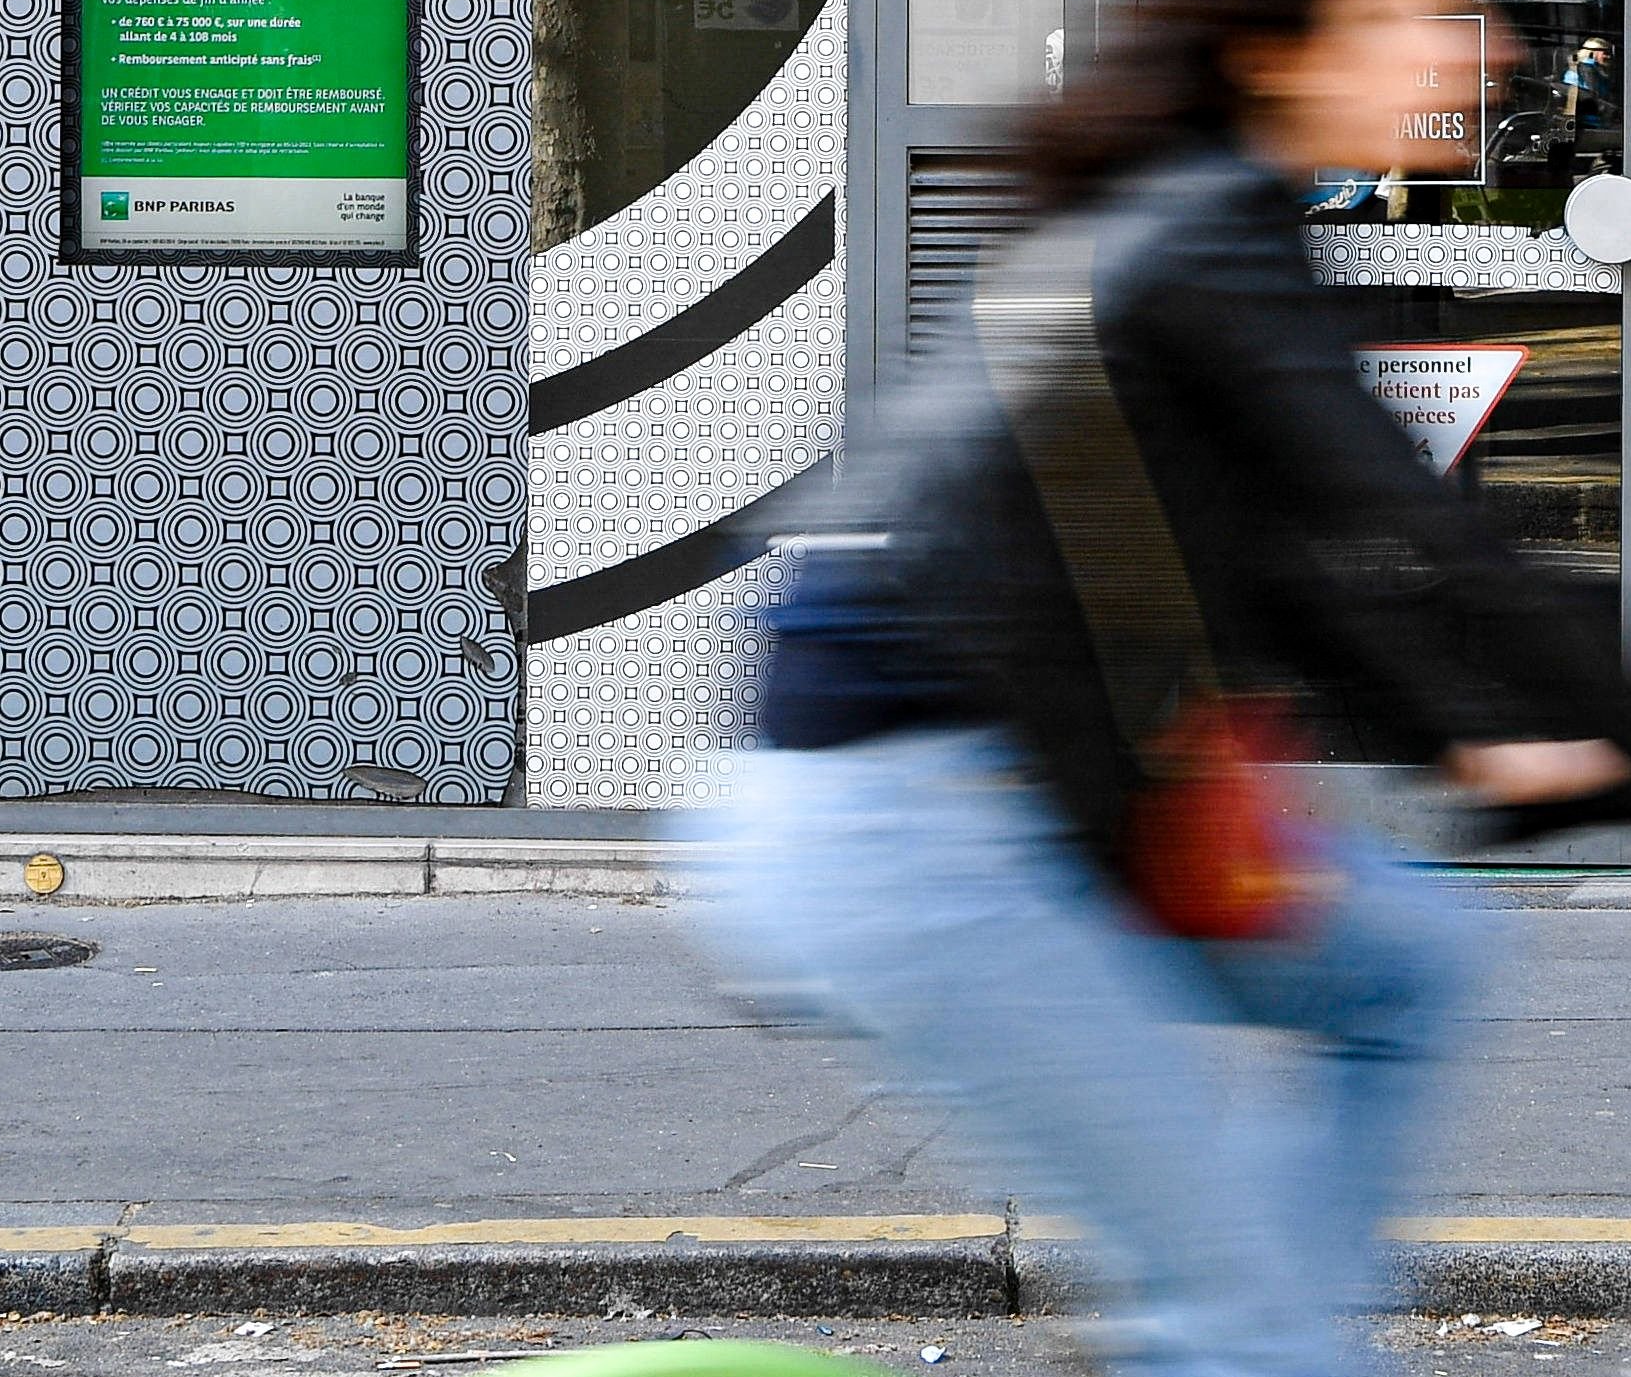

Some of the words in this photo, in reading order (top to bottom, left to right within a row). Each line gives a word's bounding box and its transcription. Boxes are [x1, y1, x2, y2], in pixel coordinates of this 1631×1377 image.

[119, 17, 132, 28] de
[176, 17, 189, 28] 75
[192, 17, 212, 28] 000
[227, 19, 244, 28] sur
[247, 19, 267, 28] une
[269, 17, 301, 28] durée
[119, 32, 151, 43] allant
[154, 32, 167, 43] de
[169, 32, 177, 43] 4
[179, 32, 186, 43] à
[189, 32, 209, 43] 108
[211, 32, 237, 43] mois
[118, 54, 207, 65] Remboursement
[261, 56, 285, 65] sans
[101, 88, 118, 99] UN
[120, 86, 159, 99] CRÉDIT
[162, 88, 192, 100] VOUS
[194, 88, 238, 100] ENGAGE
[241, 88, 254, 100] ET
[257, 88, 283, 100] DOIT
[286, 86, 313, 100] ÊTRE
[315, 86, 386, 100] REMBOURSÉ.
[101, 100, 146, 113] VÉRIFIEZ
[150, 102, 171, 113] VOS
[173, 100, 230, 113] CAPACITÉS
[233, 102, 247, 113] DE
[250, 102, 347, 114] REMBOURSEMENT
[349, 102, 385, 114] AVANT
[101, 115, 116, 126] DE
[118, 115, 149, 126] VOUS
[152, 115, 206, 127] ENGAGER.
[343, 193, 353, 202] La
[355, 193, 385, 204] banque
[134, 201, 166, 213] BNP
[169, 201, 235, 213] PARIBAS
[356, 202, 385, 212] monde
[340, 211, 354, 221] qui
[355, 211, 385, 222] change
[1357, 359, 1370, 373] e
[1378, 356, 1471, 378] personnel
[1371, 380, 1442, 399] détient
[1449, 385, 1480, 402] pas
[1392, 405, 1456, 427] spèces
